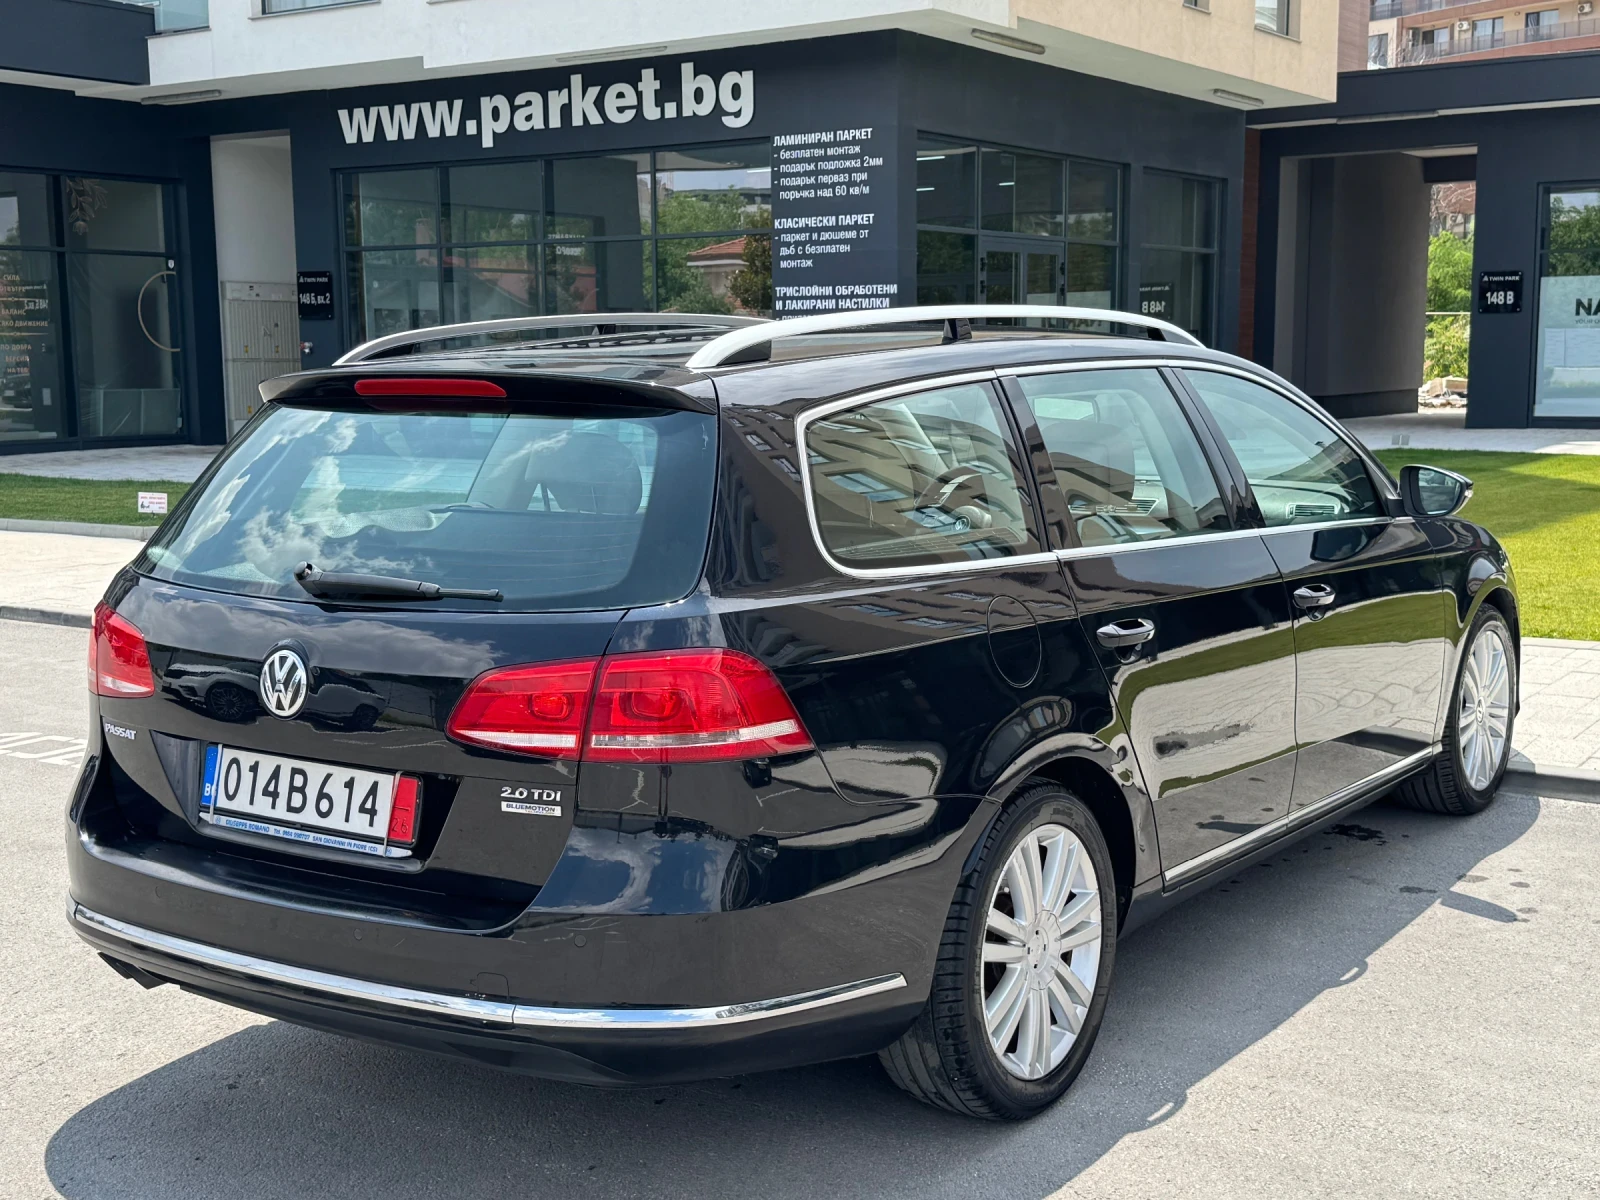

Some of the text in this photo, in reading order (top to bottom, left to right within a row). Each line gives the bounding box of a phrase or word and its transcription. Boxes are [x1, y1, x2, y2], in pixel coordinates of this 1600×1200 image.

[338, 62, 754, 148] www.parket.bg
[773, 128, 873, 146] ЛАМИНИРАН ПАРКЕТ
[780, 145, 861, 159] безплатен монтаж
[780, 156, 883, 173] подарък подложка 2мм
[780, 172, 868, 187] подарък перваз при
[779, 184, 870, 201] поръчка над 60 кв/м
[774, 213, 874, 229] КЛАСИЧЕСКИ ПАРКЕТ
[780, 229, 869, 243] паркет и дюшеме от
[780, 243, 850, 256] дъб с безплатен
[780, 259, 813, 268] монтаж
[775, 284, 897, 297] ТРИСЛОЙНИ ОБРАБОТЕНИ
[299, 293, 311, 304] 148
[775, 298, 889, 310] И ЛАКИРАНИ НАСТИЛКИ
[1486, 291, 1505, 305] 148
[104, 722, 137, 740] PASSAT
[223, 756, 379, 828] 014B614
[531, 788, 562, 802] TDI
[506, 802, 556, 813] BLUEMOTION
[391, 817, 409, 834] 26
